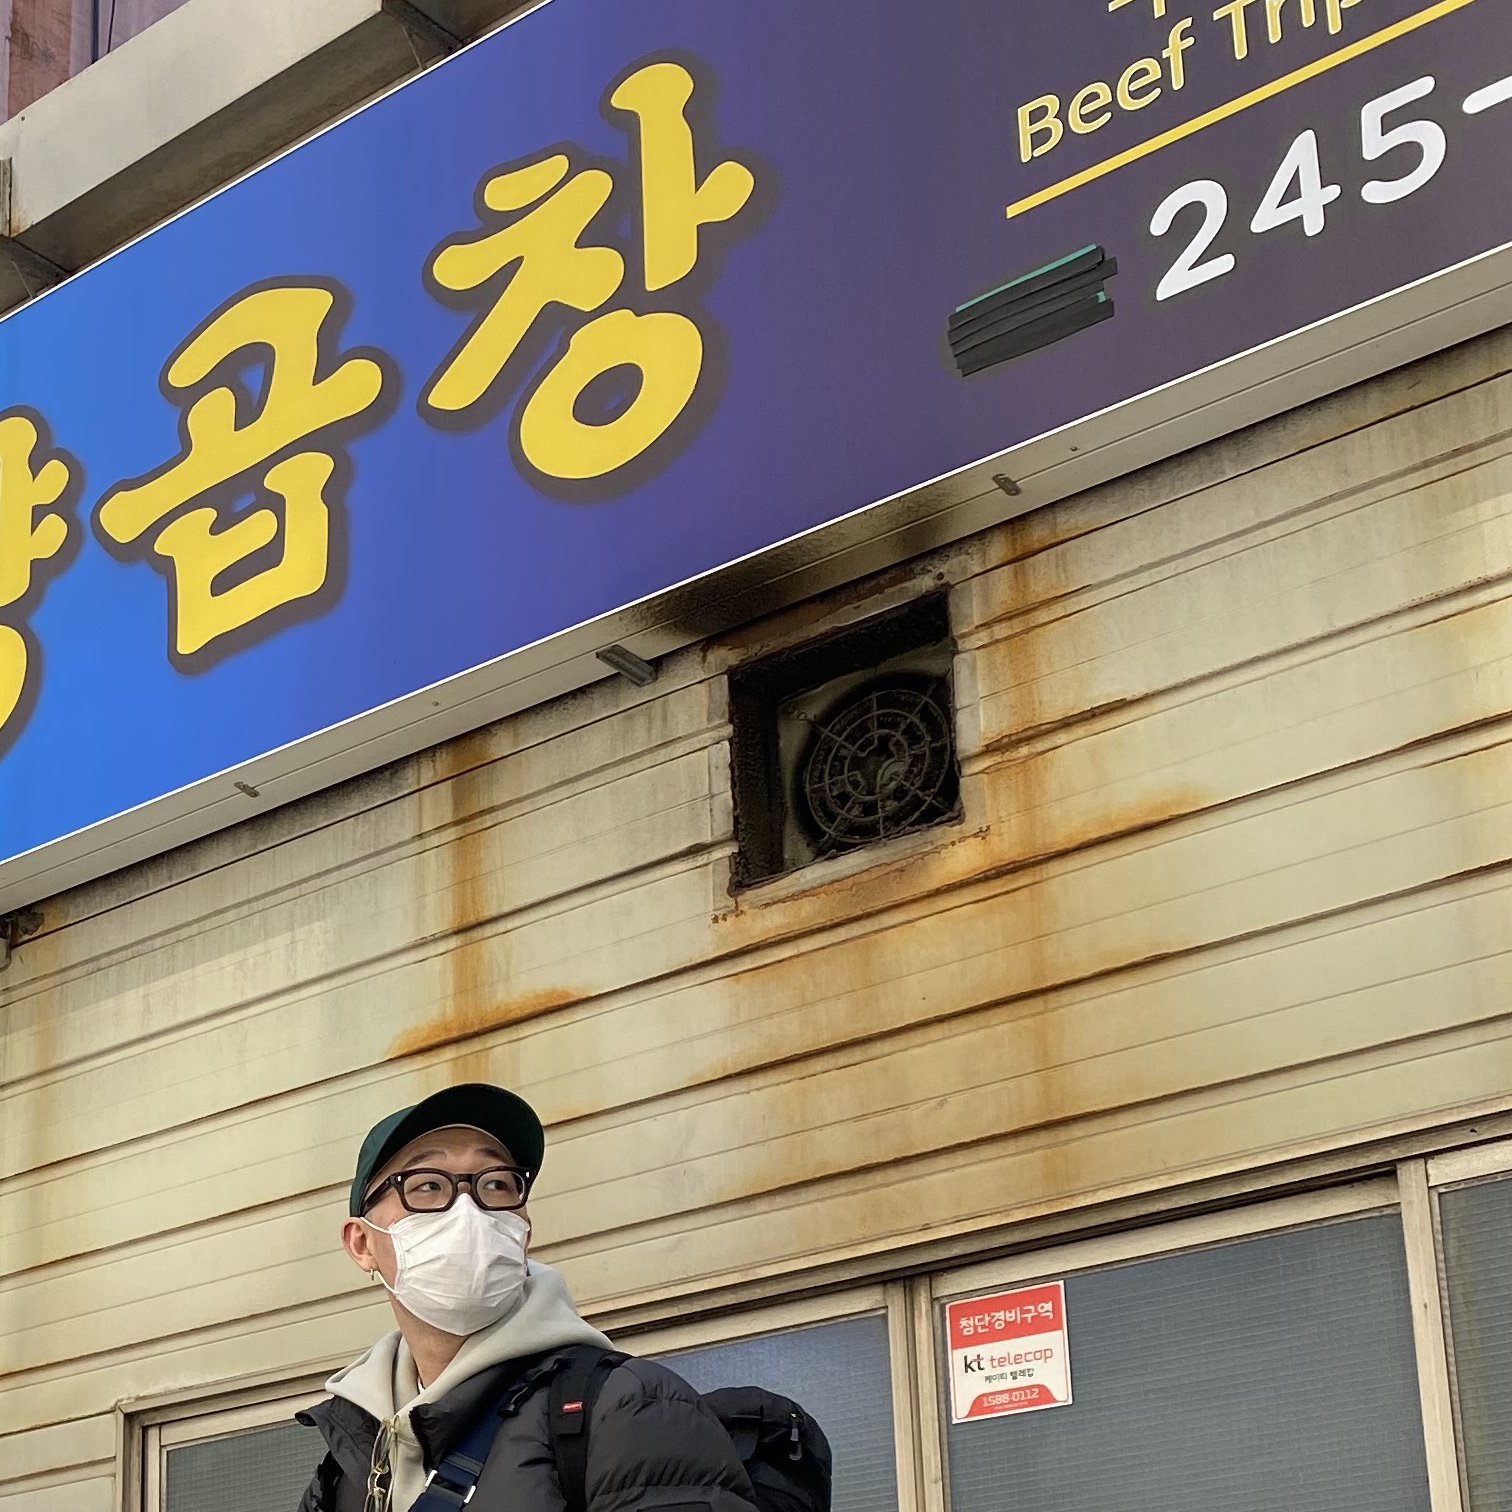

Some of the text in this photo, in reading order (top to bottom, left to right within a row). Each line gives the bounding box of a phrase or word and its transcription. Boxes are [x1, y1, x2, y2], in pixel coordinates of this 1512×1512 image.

[1017, 17, 1196, 164] Beef
[958, 1300, 1055, 1337] 첨단경비구역
[963, 1348, 1054, 1374] kt telecop
